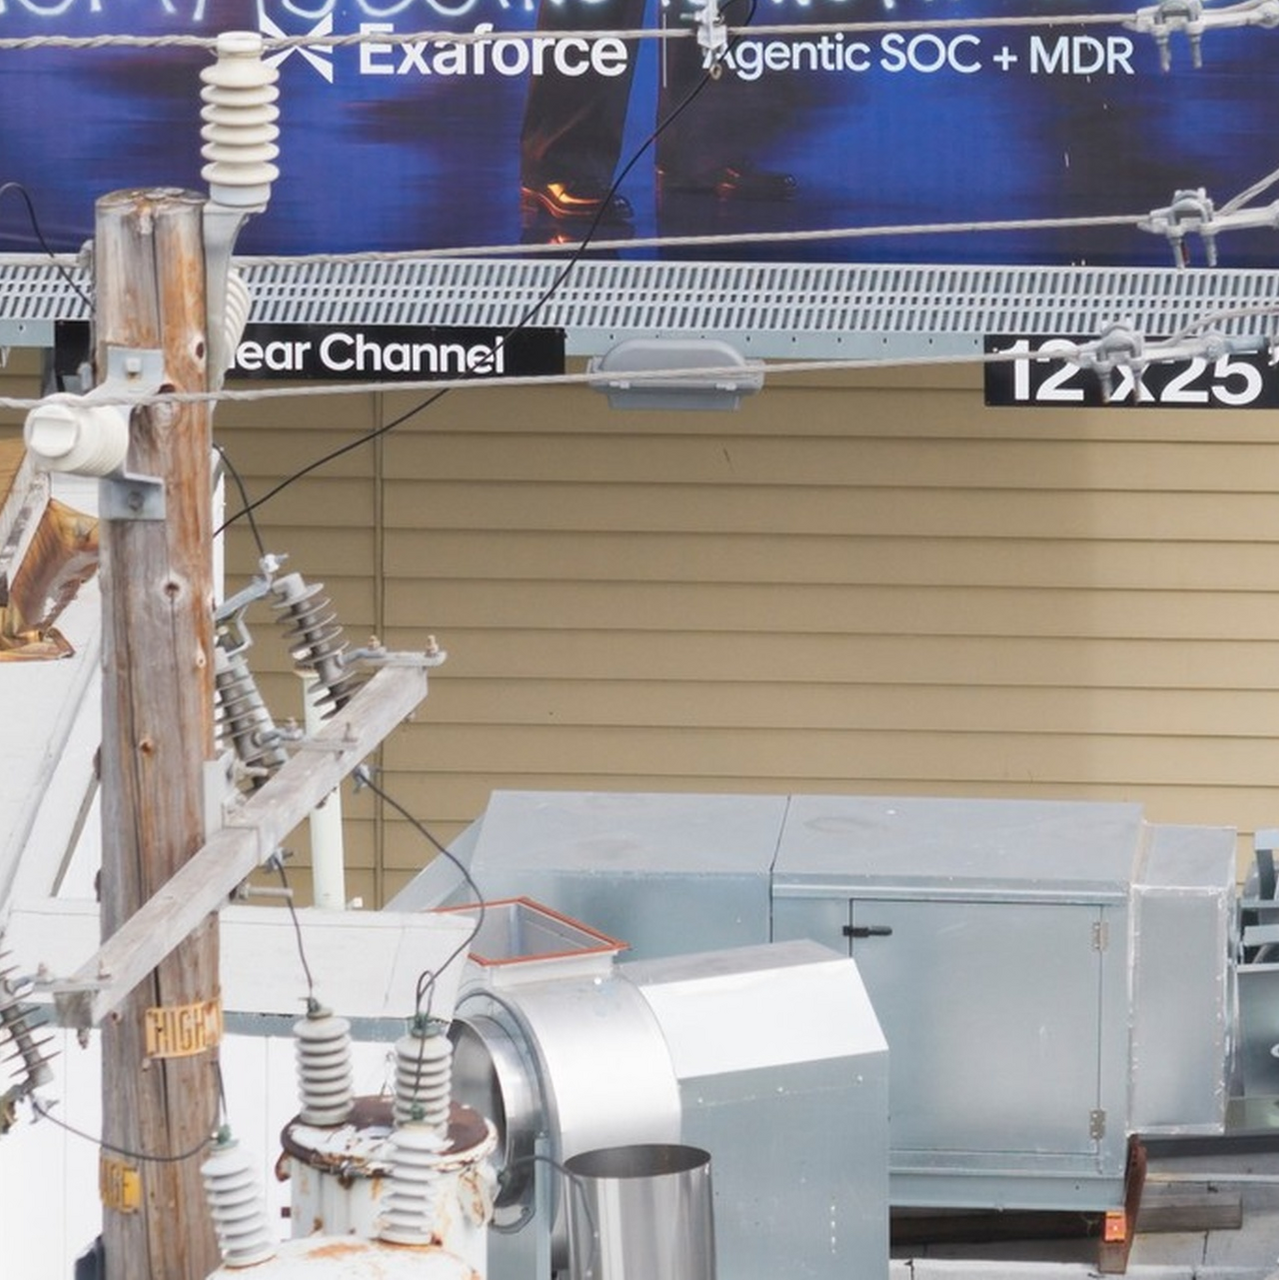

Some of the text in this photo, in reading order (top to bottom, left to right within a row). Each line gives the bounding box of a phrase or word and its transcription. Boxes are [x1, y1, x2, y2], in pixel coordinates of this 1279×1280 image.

[360, 22, 628, 76] Exaforce
[880, 33, 982, 73] SOC
[1029, 36, 1135, 75] MDR
[229, 333, 504, 375] ear Channel
[153, 1008, 207, 1053] HIGH
